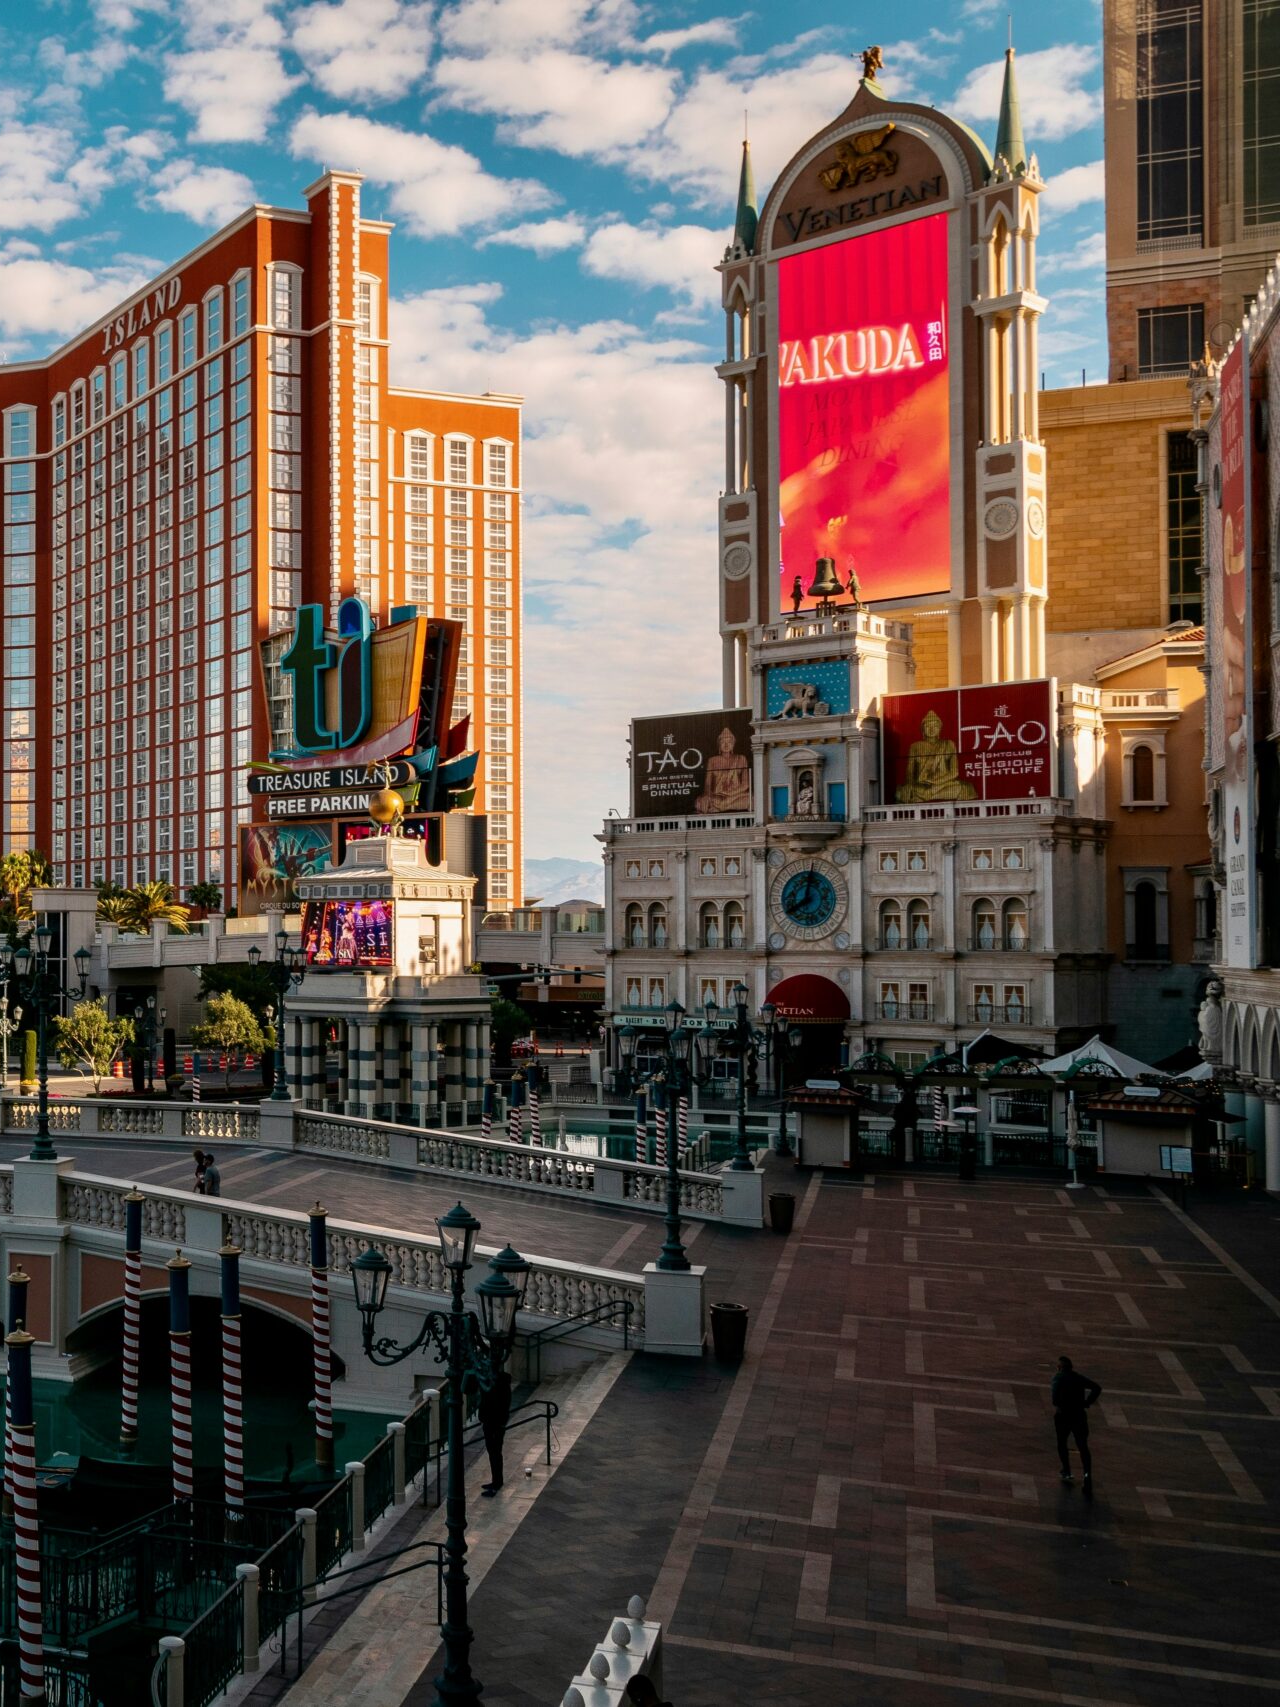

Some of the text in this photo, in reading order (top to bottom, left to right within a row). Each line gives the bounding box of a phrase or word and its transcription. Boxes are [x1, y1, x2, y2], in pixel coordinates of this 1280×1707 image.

[777, 175, 942, 242] VENETIAN
[102, 276, 181, 355] ISLAND
[960, 720, 1046, 751] TAO
[975, 750, 1032, 759] NGHTCLUB
[637, 748, 703, 774] TAO
[964, 758, 1044, 770] RELIGIOUS
[966, 766, 1042, 777] NIGHTLIFE
[257, 765, 399, 793] TREASURE ISLAND
[642, 781, 699, 791] SPIRITUAL
[650, 788, 691, 797] DINING
[268, 794, 370, 815] FREE PARKIN
[259, 901, 281, 911] CIRQUE
[282, 901, 291, 909] DU
[776, 1007, 814, 1015] NETIAN
[652, 1018, 702, 1027] BOHON
